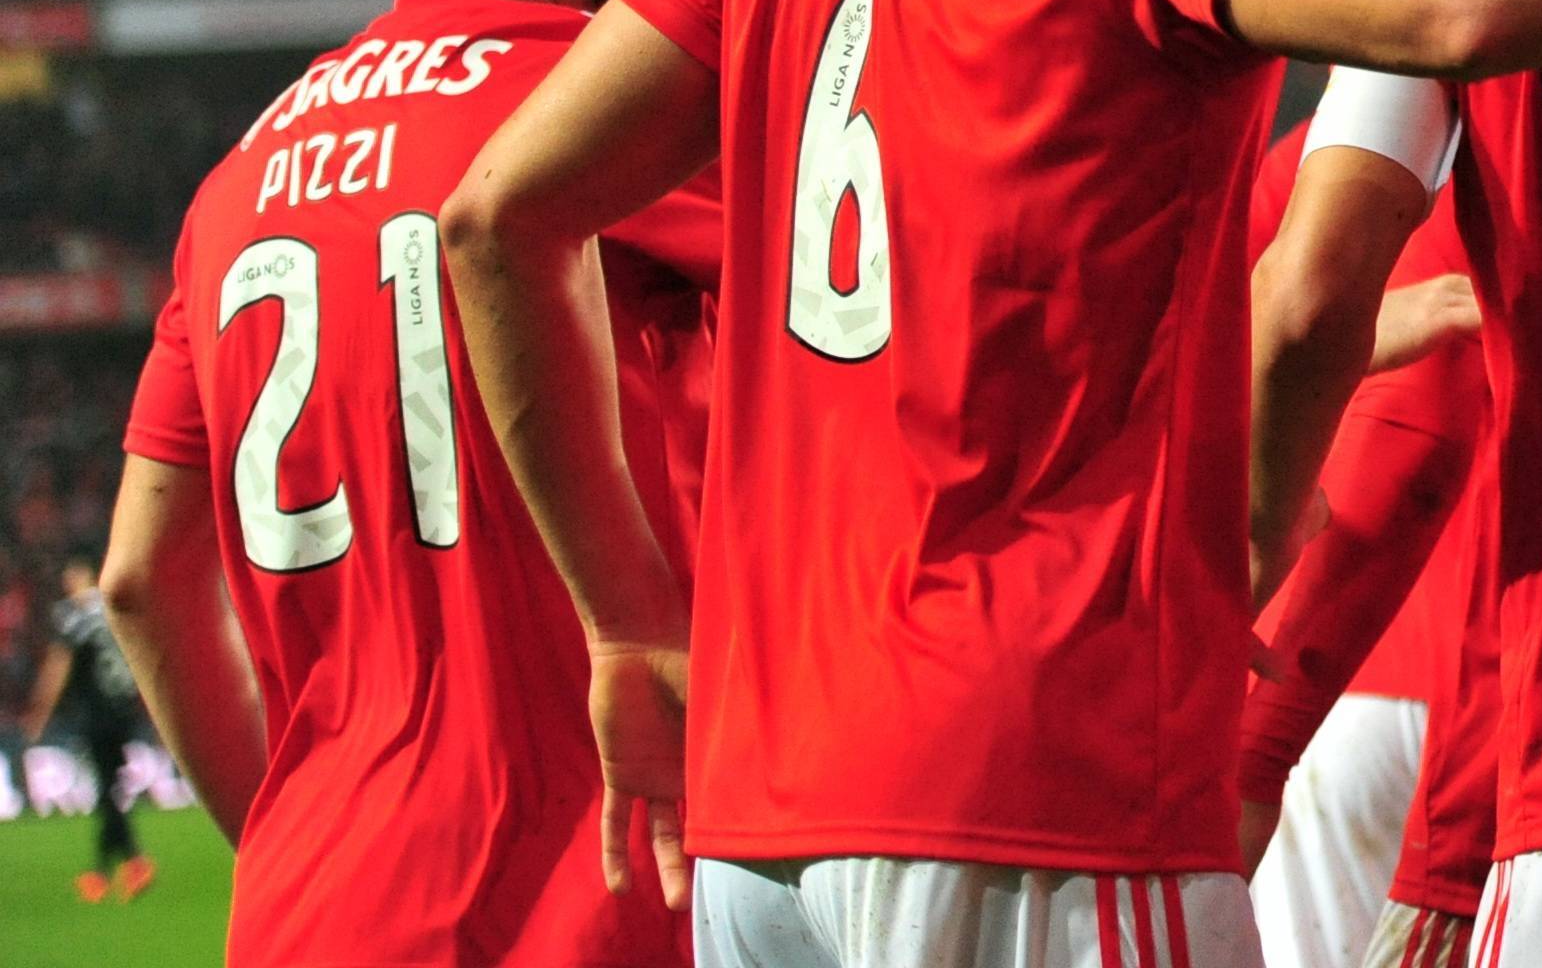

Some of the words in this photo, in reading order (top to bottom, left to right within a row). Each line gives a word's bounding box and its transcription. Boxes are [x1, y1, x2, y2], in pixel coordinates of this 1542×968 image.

[272, 35, 514, 132] SAGRES
[829, 64, 850, 108] LIGA
[256, 122, 397, 215] PIZZI
[410, 284, 424, 325] LIGA
[217, 209, 460, 575] 21
